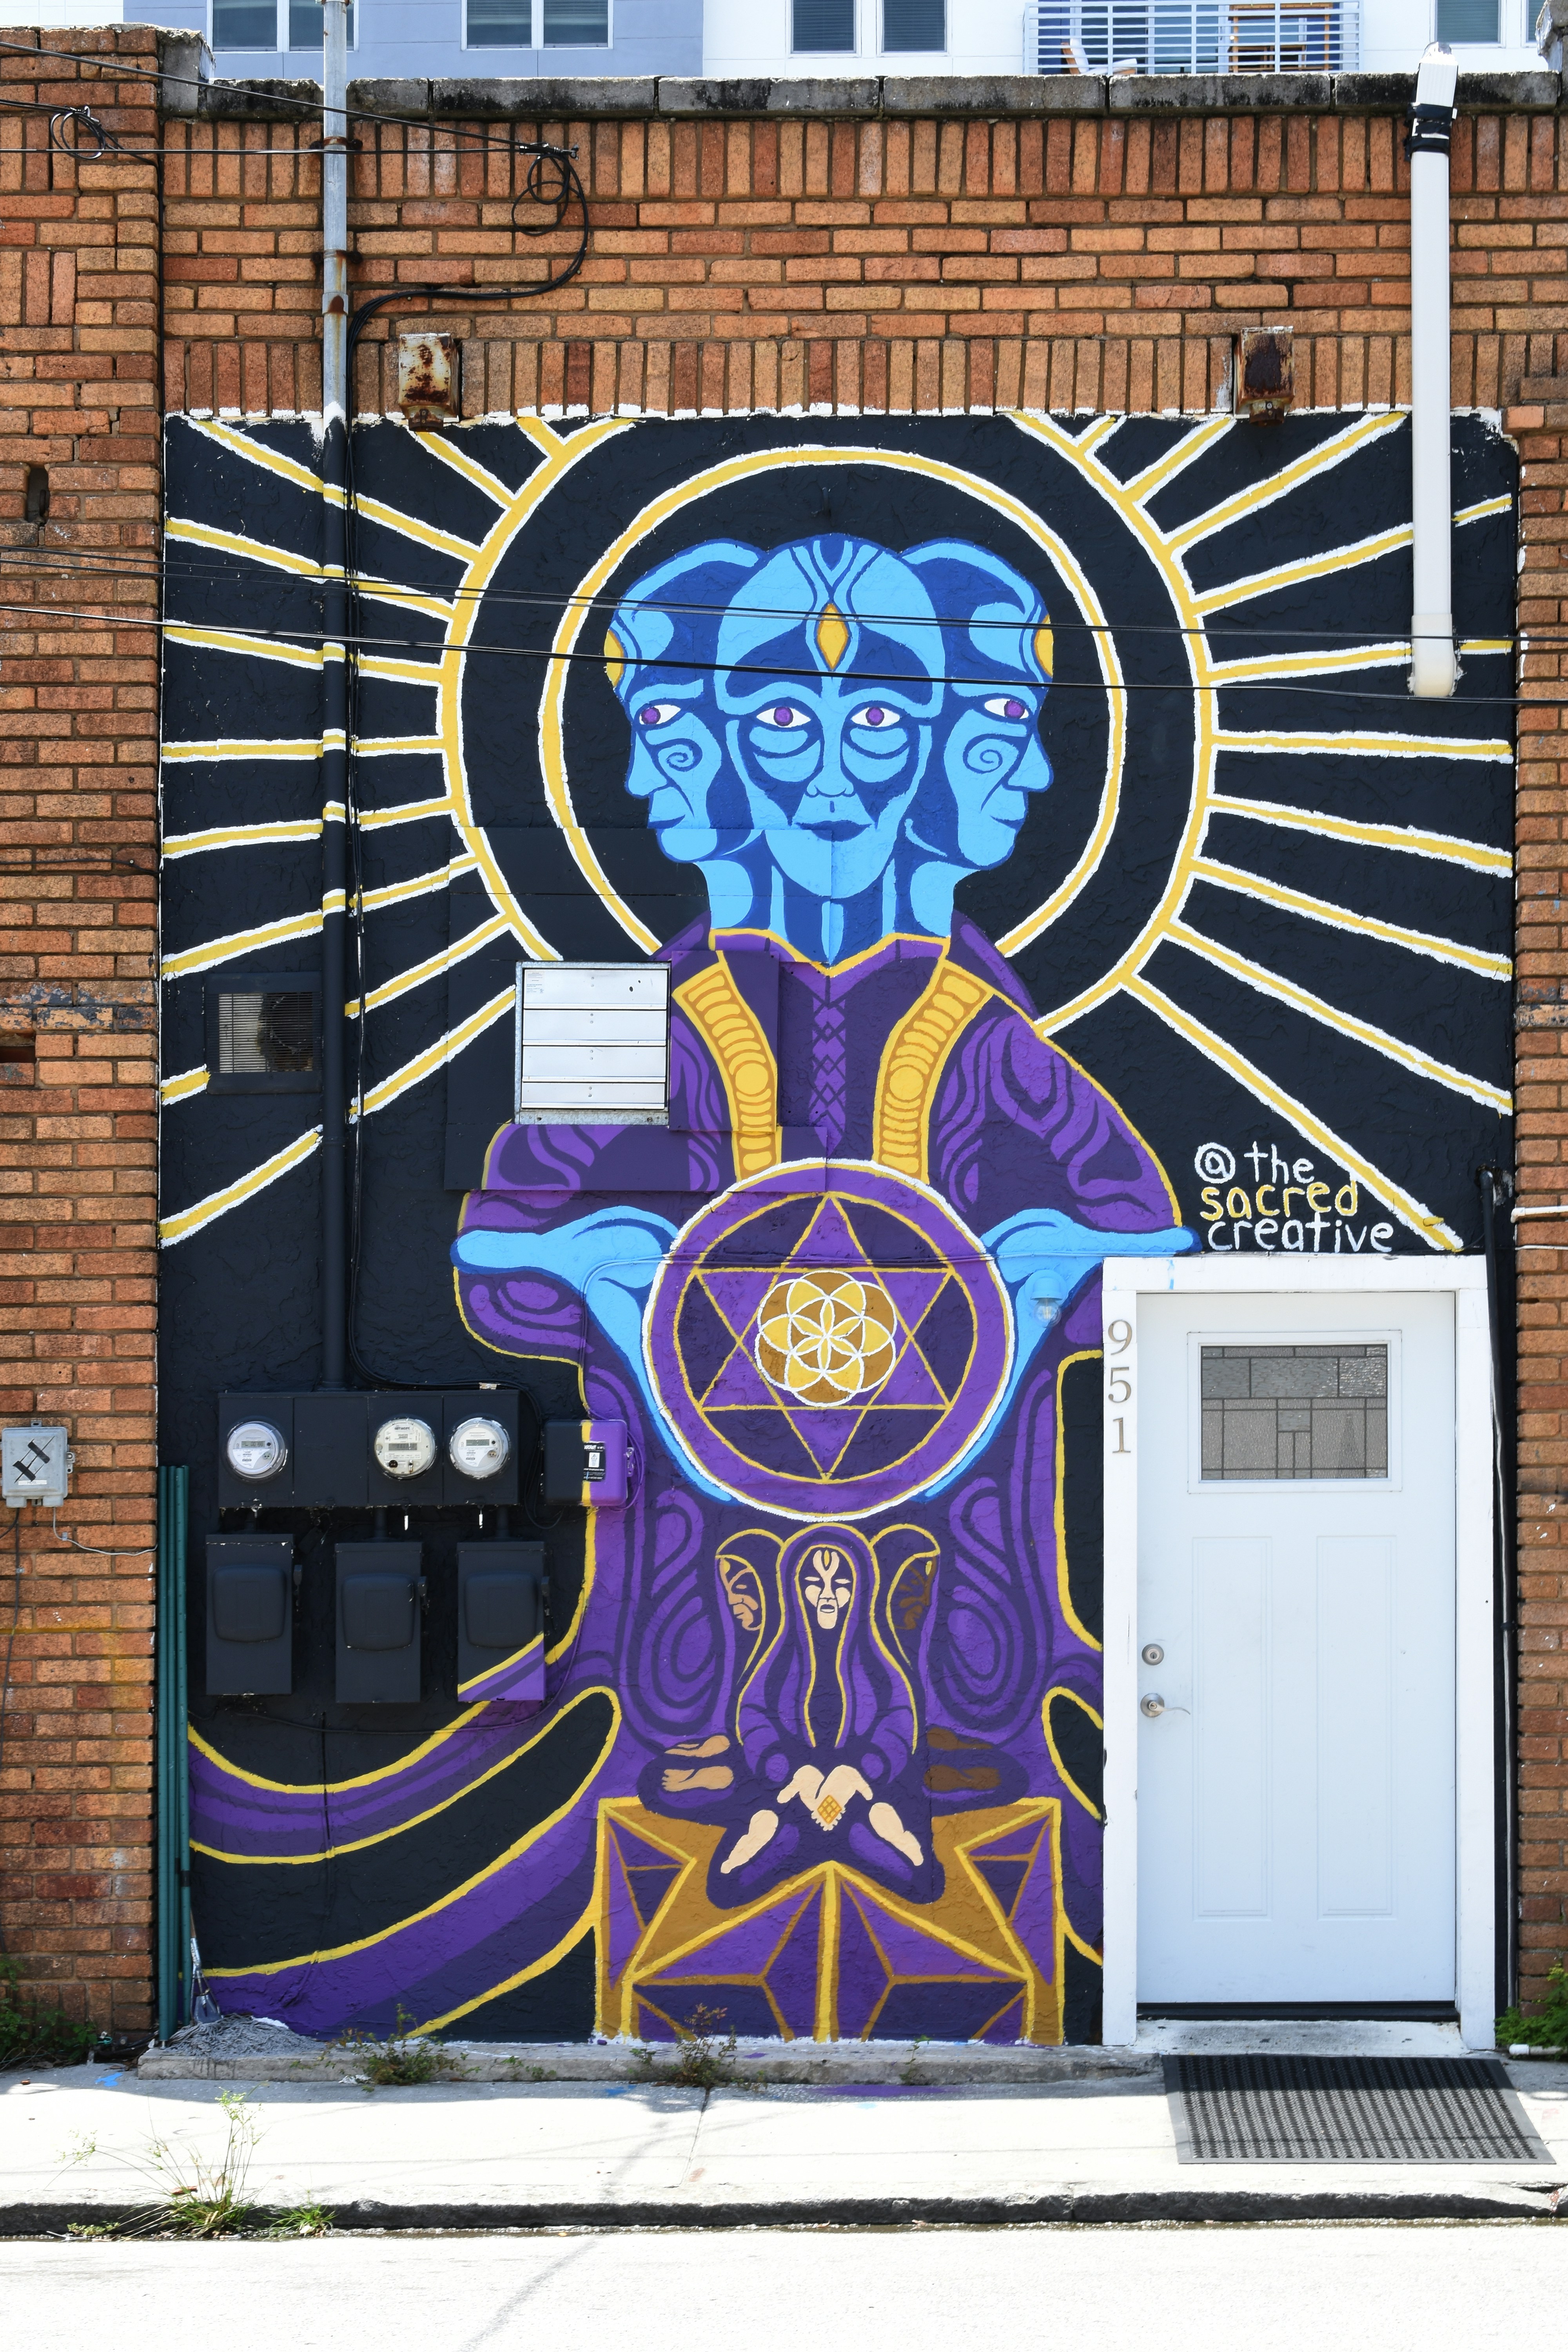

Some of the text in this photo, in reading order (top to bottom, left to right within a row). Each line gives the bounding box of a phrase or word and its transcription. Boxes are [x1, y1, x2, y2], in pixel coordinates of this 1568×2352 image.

[1200, 1181, 1359, 1221] sacred
[1208, 1211, 1394, 1253] creative
[1108, 1319, 1132, 1453] 951
